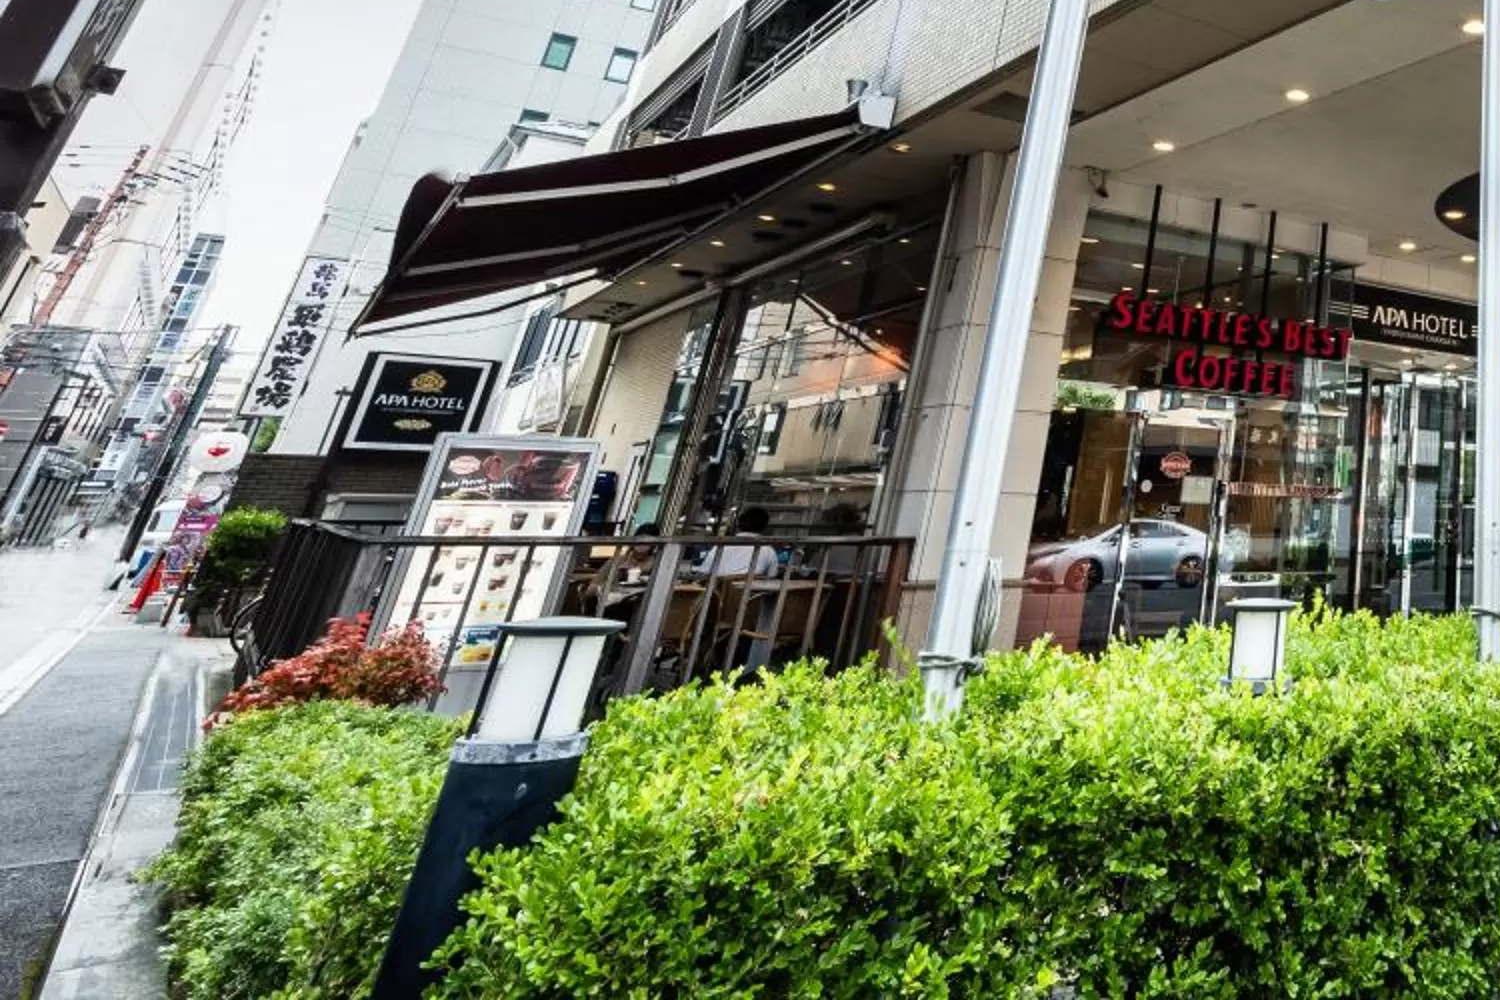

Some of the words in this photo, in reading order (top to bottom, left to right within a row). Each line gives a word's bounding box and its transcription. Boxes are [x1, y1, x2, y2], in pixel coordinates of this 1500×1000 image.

[1284, 318, 1353, 358] BEST
[1373, 305, 1409, 329] APA
[1412, 311, 1469, 339] HOTEL
[1174, 347, 1296, 399] COFFEE
[374, 393, 410, 407] APA
[411, 396, 465, 410] HOTEL
